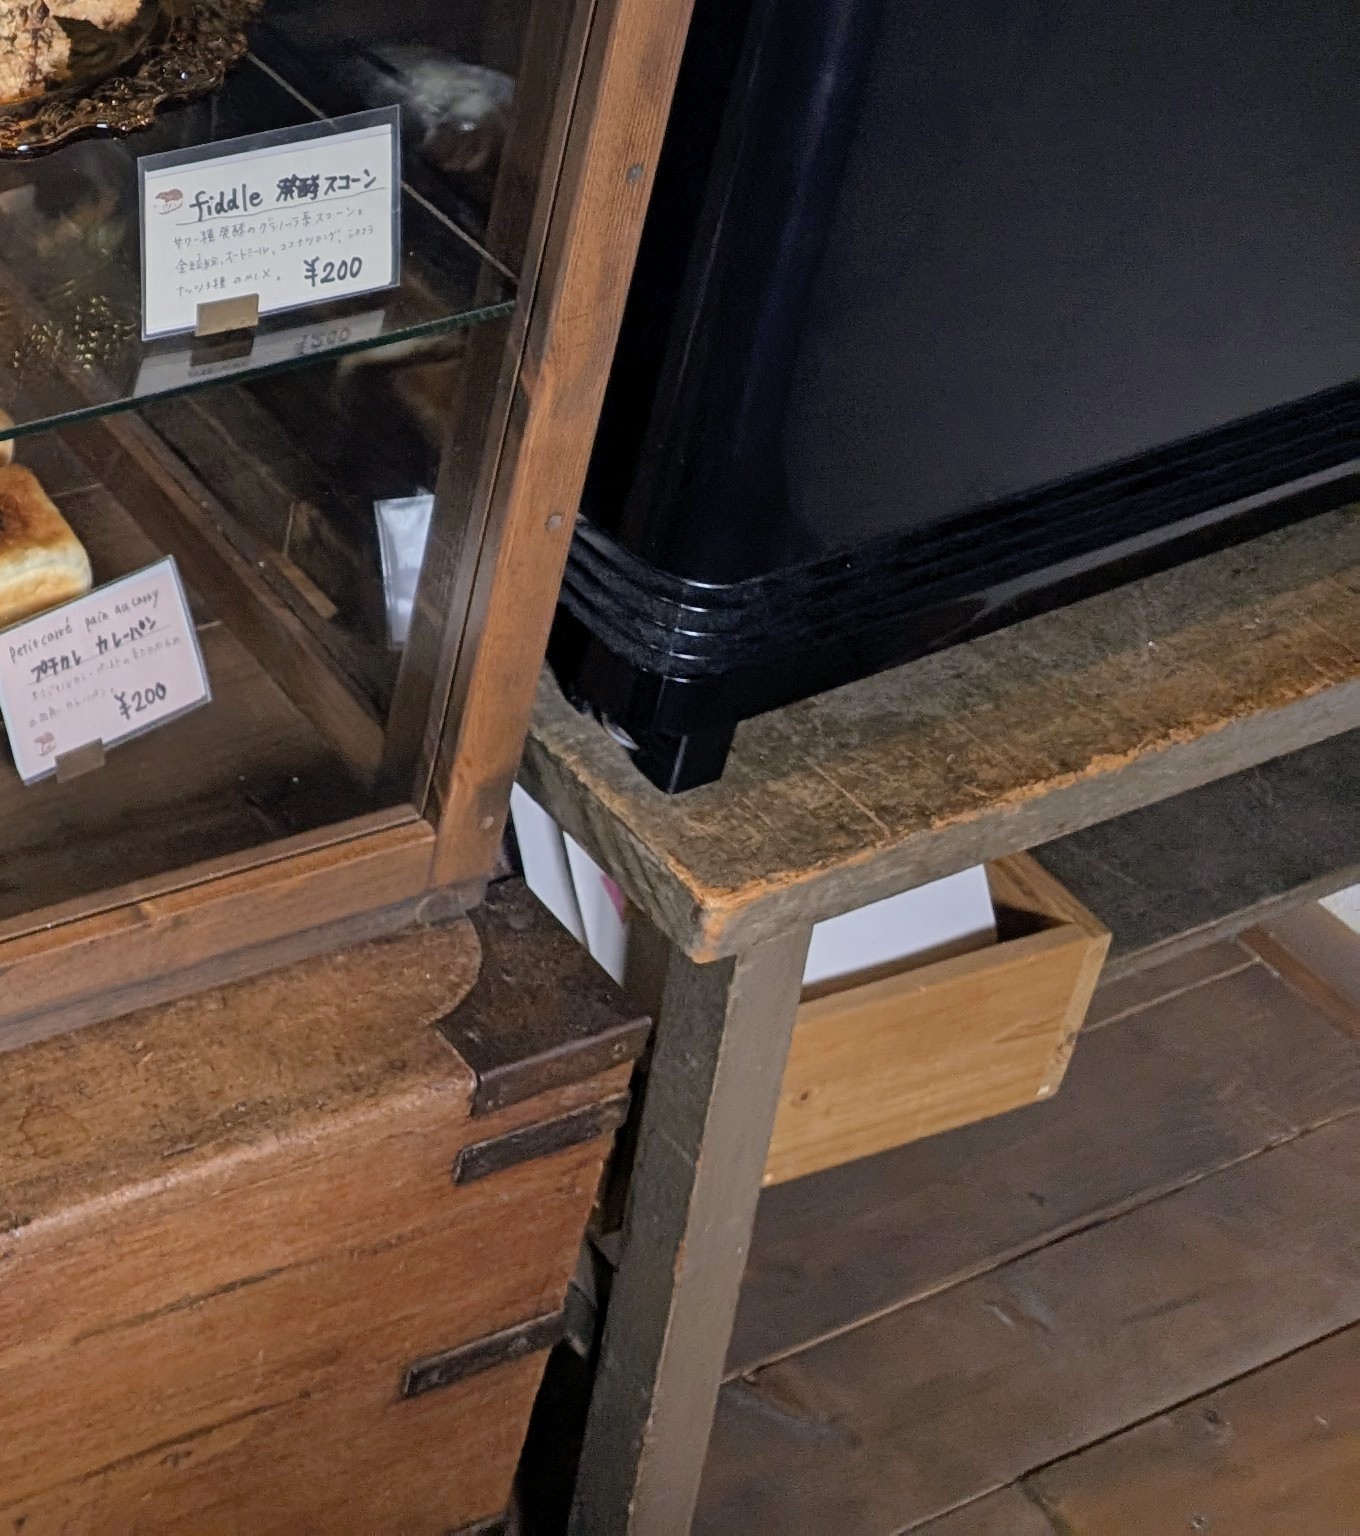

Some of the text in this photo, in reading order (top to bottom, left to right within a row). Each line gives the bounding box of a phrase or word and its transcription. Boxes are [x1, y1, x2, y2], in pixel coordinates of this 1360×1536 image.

[189, 182, 264, 223] fiddle
[303, 255, 364, 288] ¥200
[113, 681, 168, 721] ¥200
